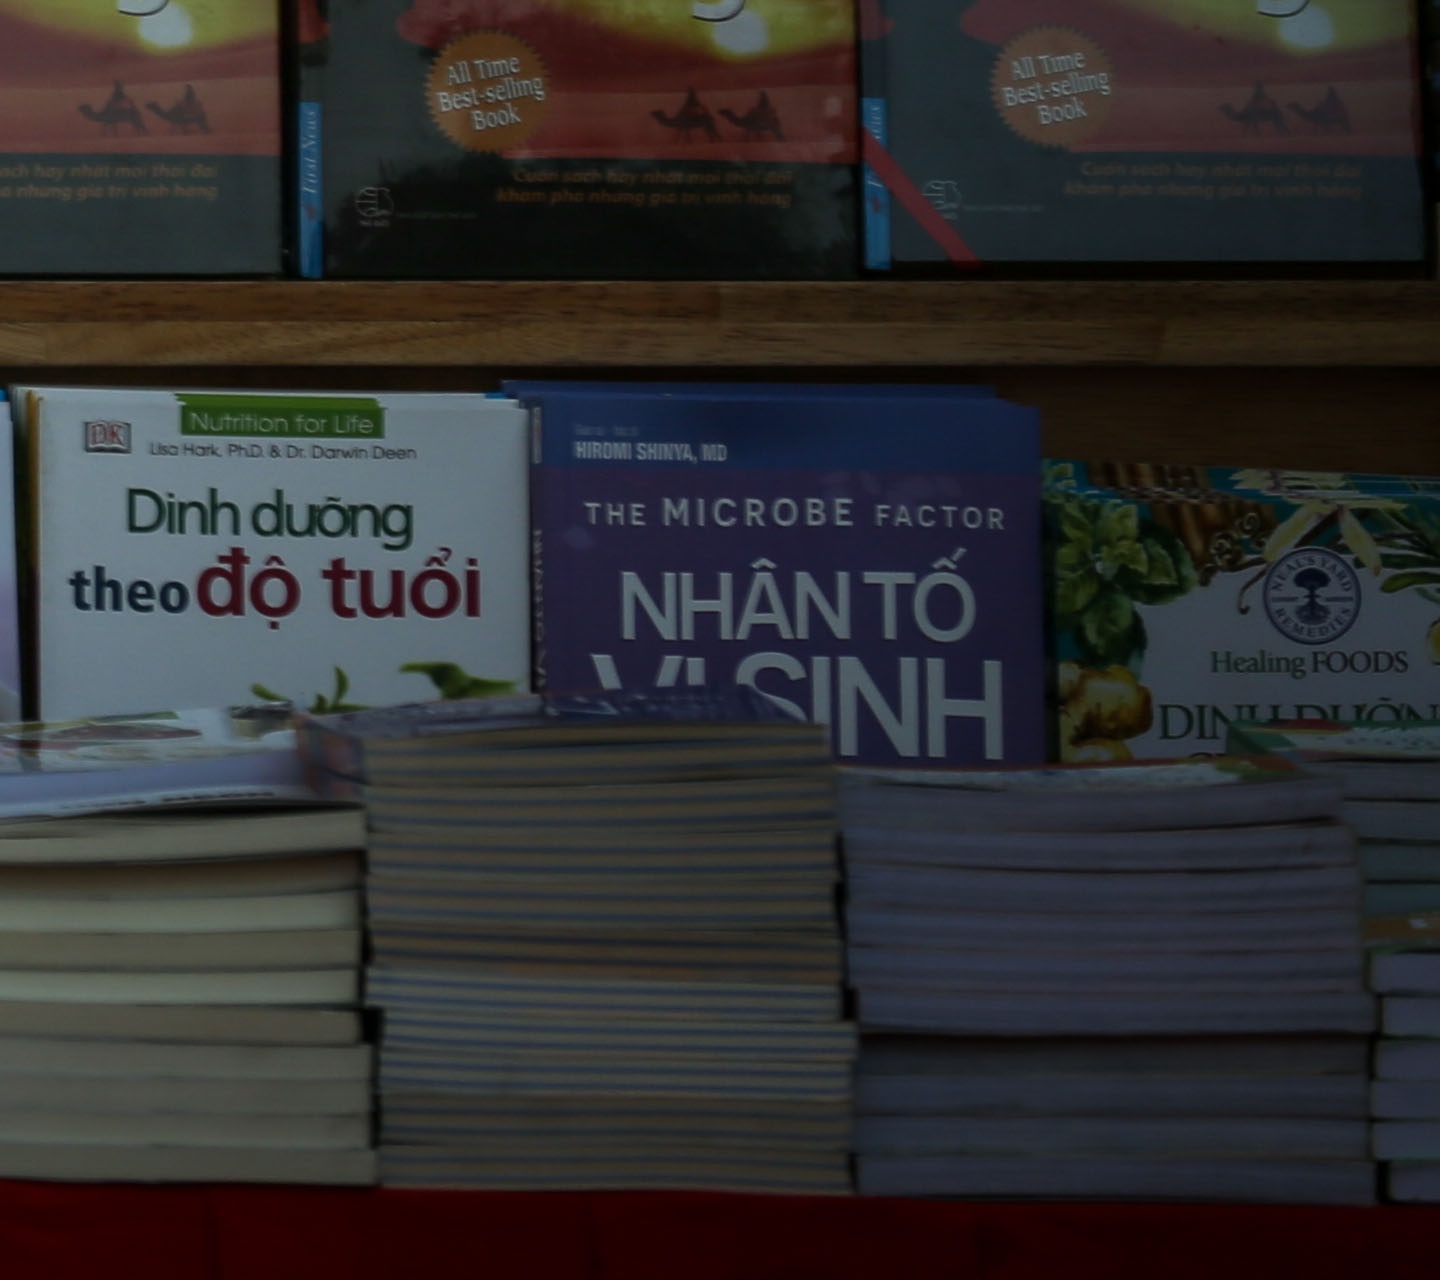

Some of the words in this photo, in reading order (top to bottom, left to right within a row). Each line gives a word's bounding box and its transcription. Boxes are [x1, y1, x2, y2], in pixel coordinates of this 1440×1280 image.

[127, 487, 240, 536] Dinh
[69, 565, 190, 614] theo
[197, 547, 300, 630] độ
[322, 547, 481, 619] tuổi
[1210, 651, 1305, 679] Healing
[1313, 651, 1408, 673] FOODS
